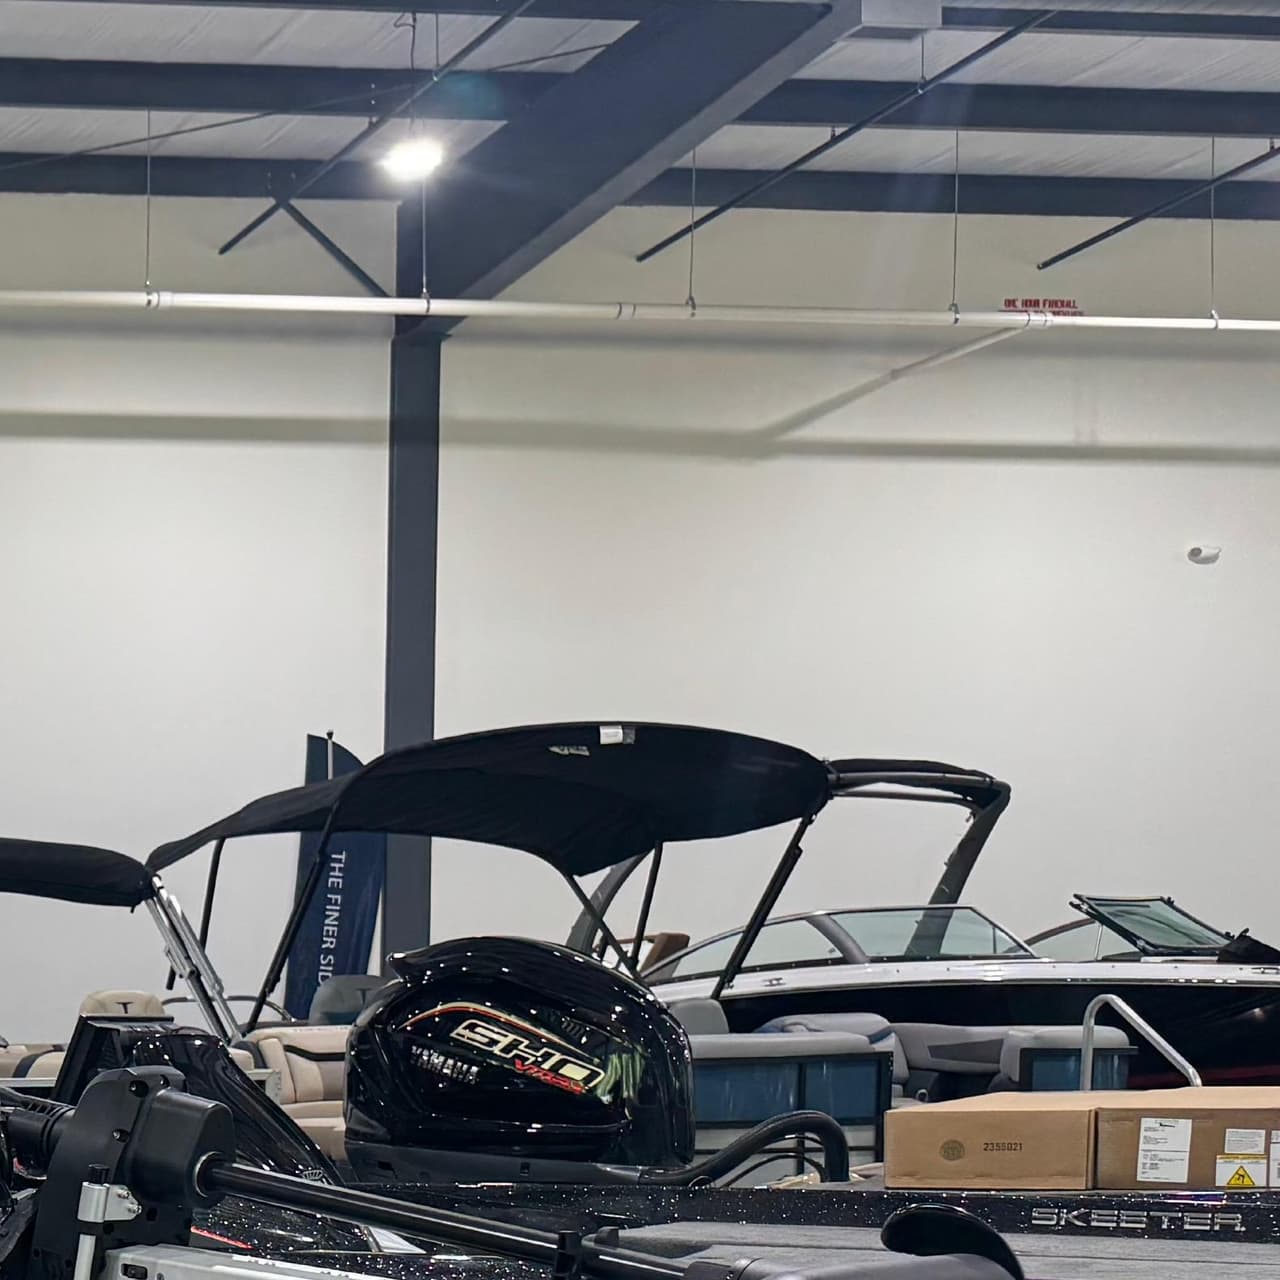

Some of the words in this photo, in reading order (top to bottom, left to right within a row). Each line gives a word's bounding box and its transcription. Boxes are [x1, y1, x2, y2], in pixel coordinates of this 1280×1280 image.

[327, 850, 346, 889] THE
[321, 893, 341, 949] FINER
[318, 954, 335, 985] SID
[410, 1044, 480, 1086] YAMAHA
[449, 1018, 606, 1090] SHO
[1031, 1207, 1247, 1232] SKEETER
